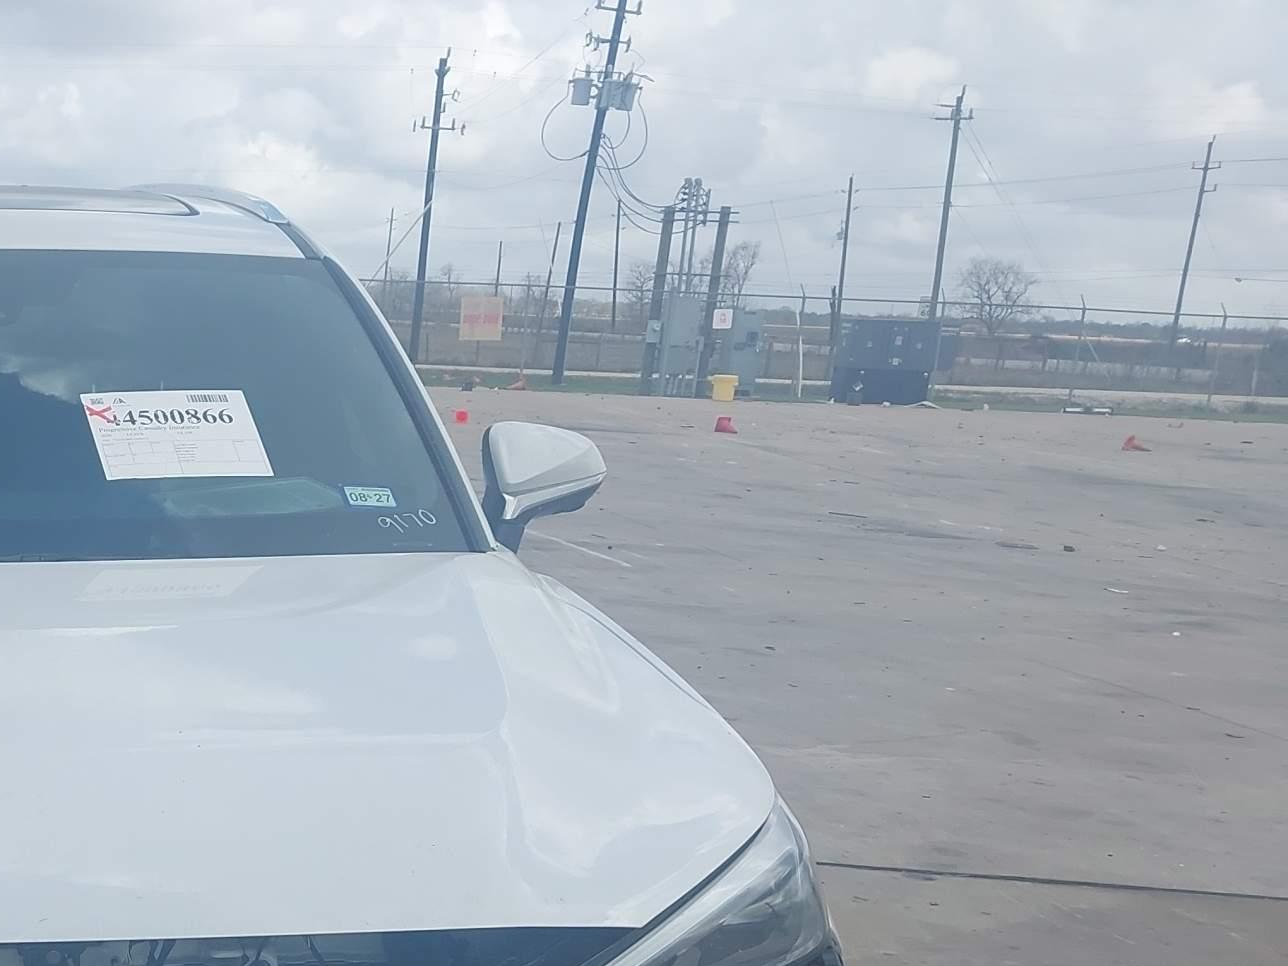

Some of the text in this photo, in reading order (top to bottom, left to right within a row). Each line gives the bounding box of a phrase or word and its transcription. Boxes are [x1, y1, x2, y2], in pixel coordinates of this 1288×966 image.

[349, 491, 391, 504] 08 27
[377, 508, 437, 534] 9170
